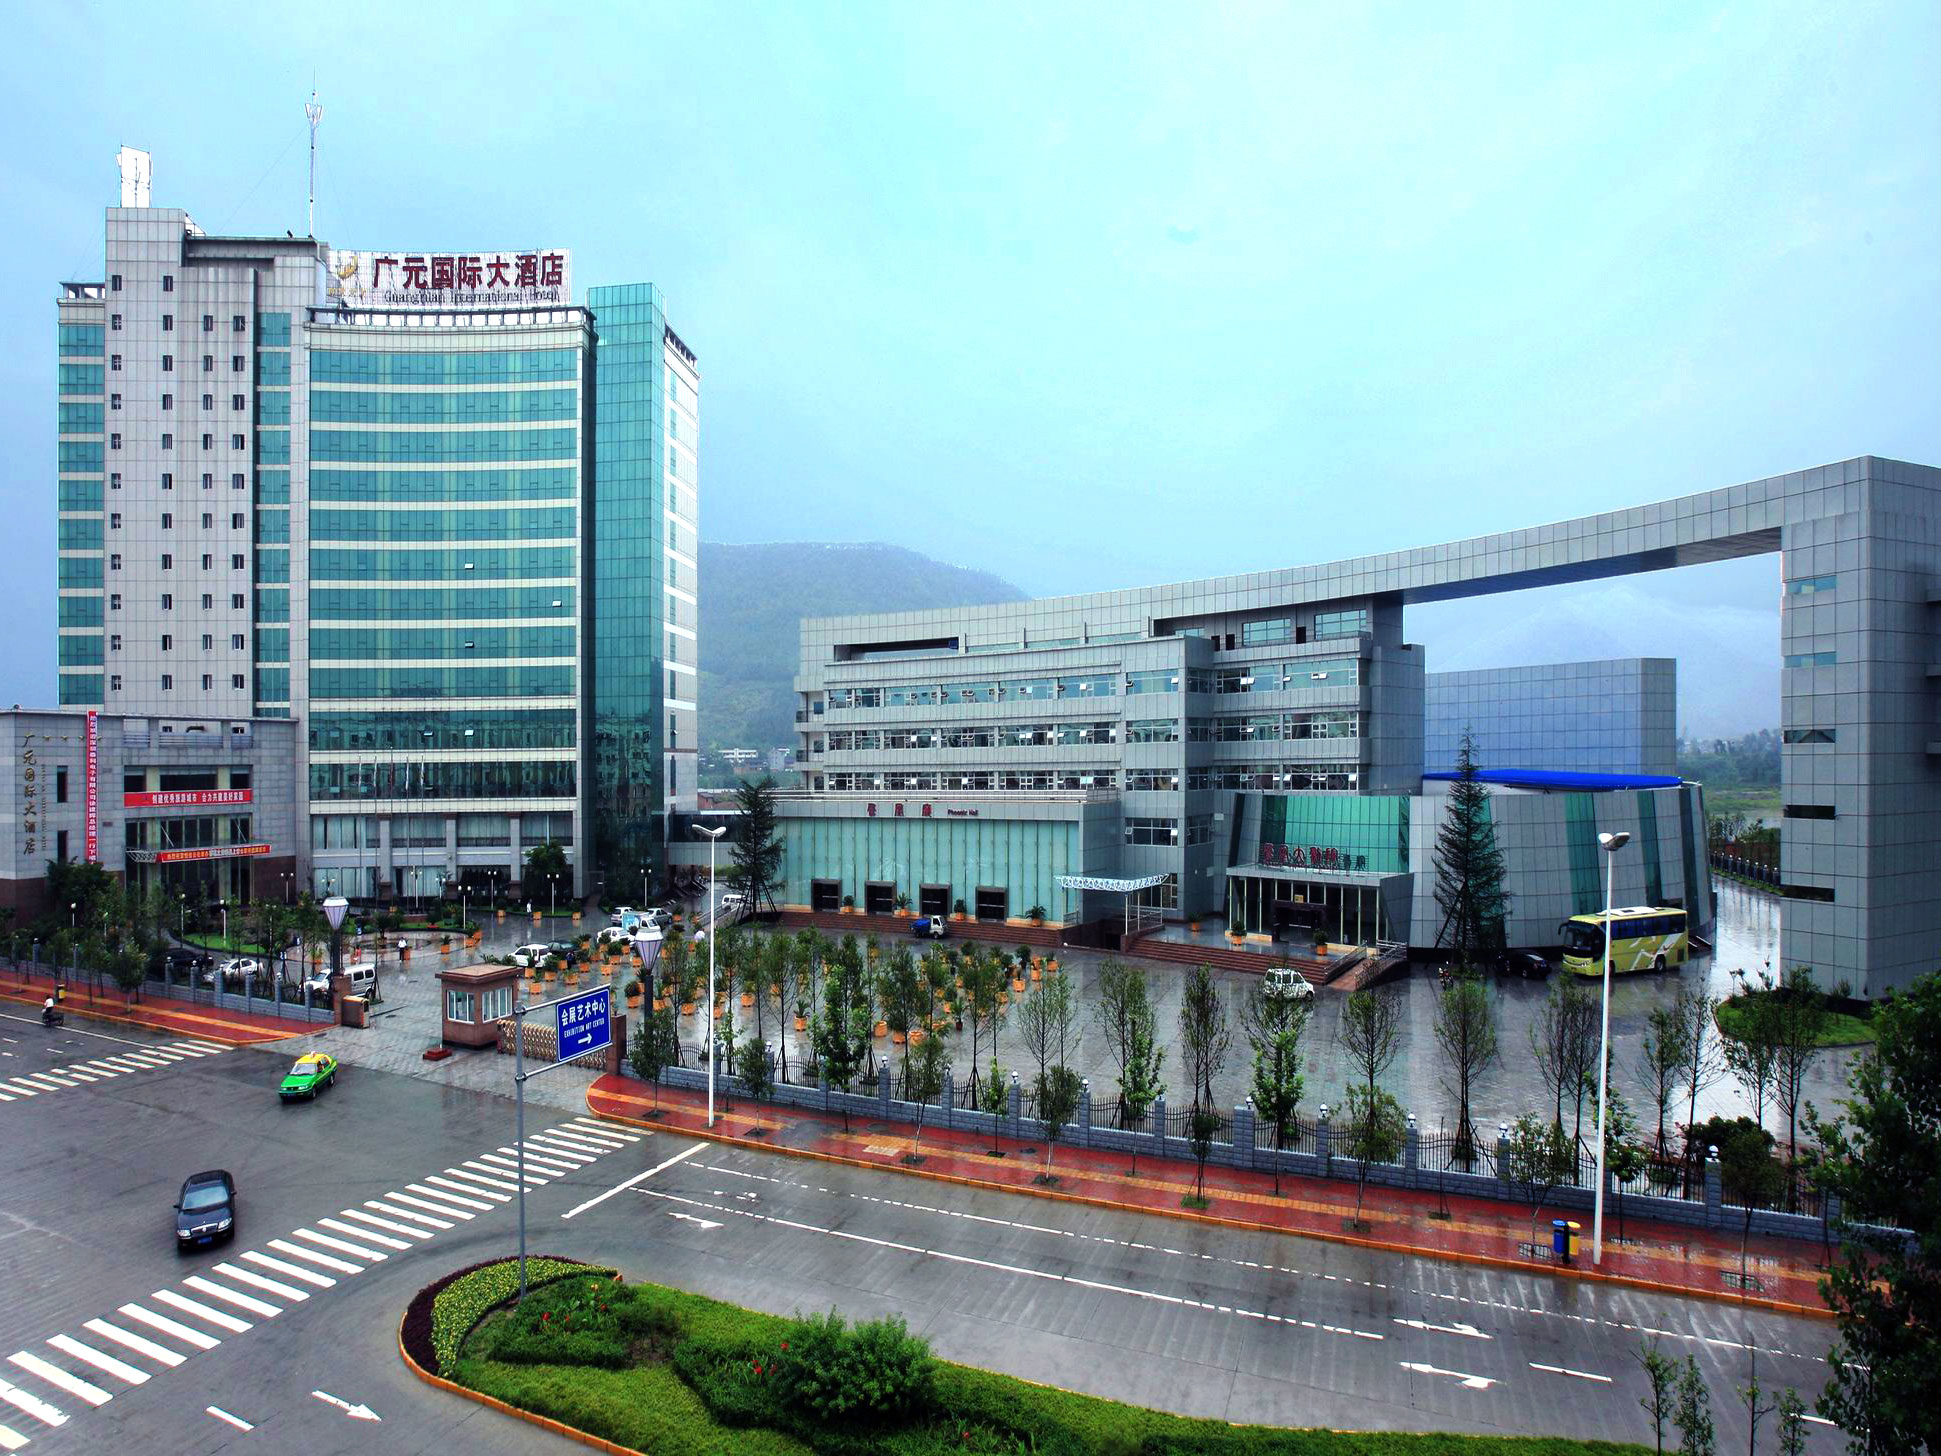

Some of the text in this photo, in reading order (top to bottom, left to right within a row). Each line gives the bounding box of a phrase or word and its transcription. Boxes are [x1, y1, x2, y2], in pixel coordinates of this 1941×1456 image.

[373, 253, 564, 289] 广元国际大酒店
[22, 733, 37, 856] 广元国际大酒店
[561, 998, 605, 1026] 会展艺术中心
